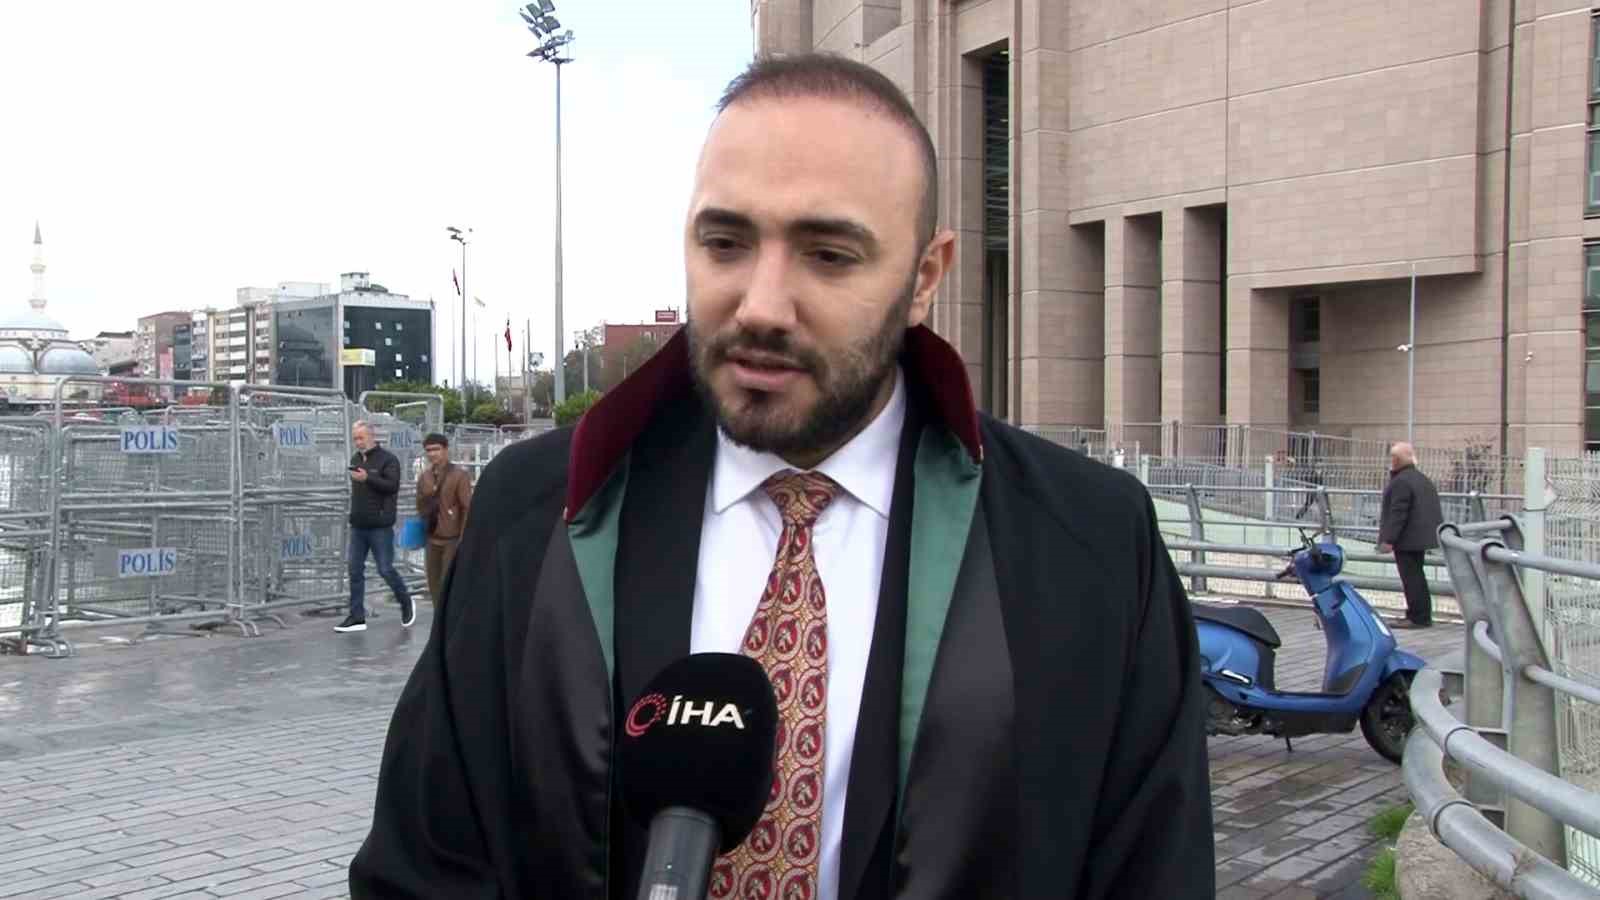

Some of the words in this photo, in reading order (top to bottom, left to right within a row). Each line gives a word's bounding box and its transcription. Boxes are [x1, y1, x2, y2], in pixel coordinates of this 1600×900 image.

[124, 426, 177, 450] POLİS
[280, 424, 308, 446] POLİS
[281, 535, 312, 557] POLİS
[120, 549, 174, 574] POLİS
[667, 696, 745, 729] İHA
